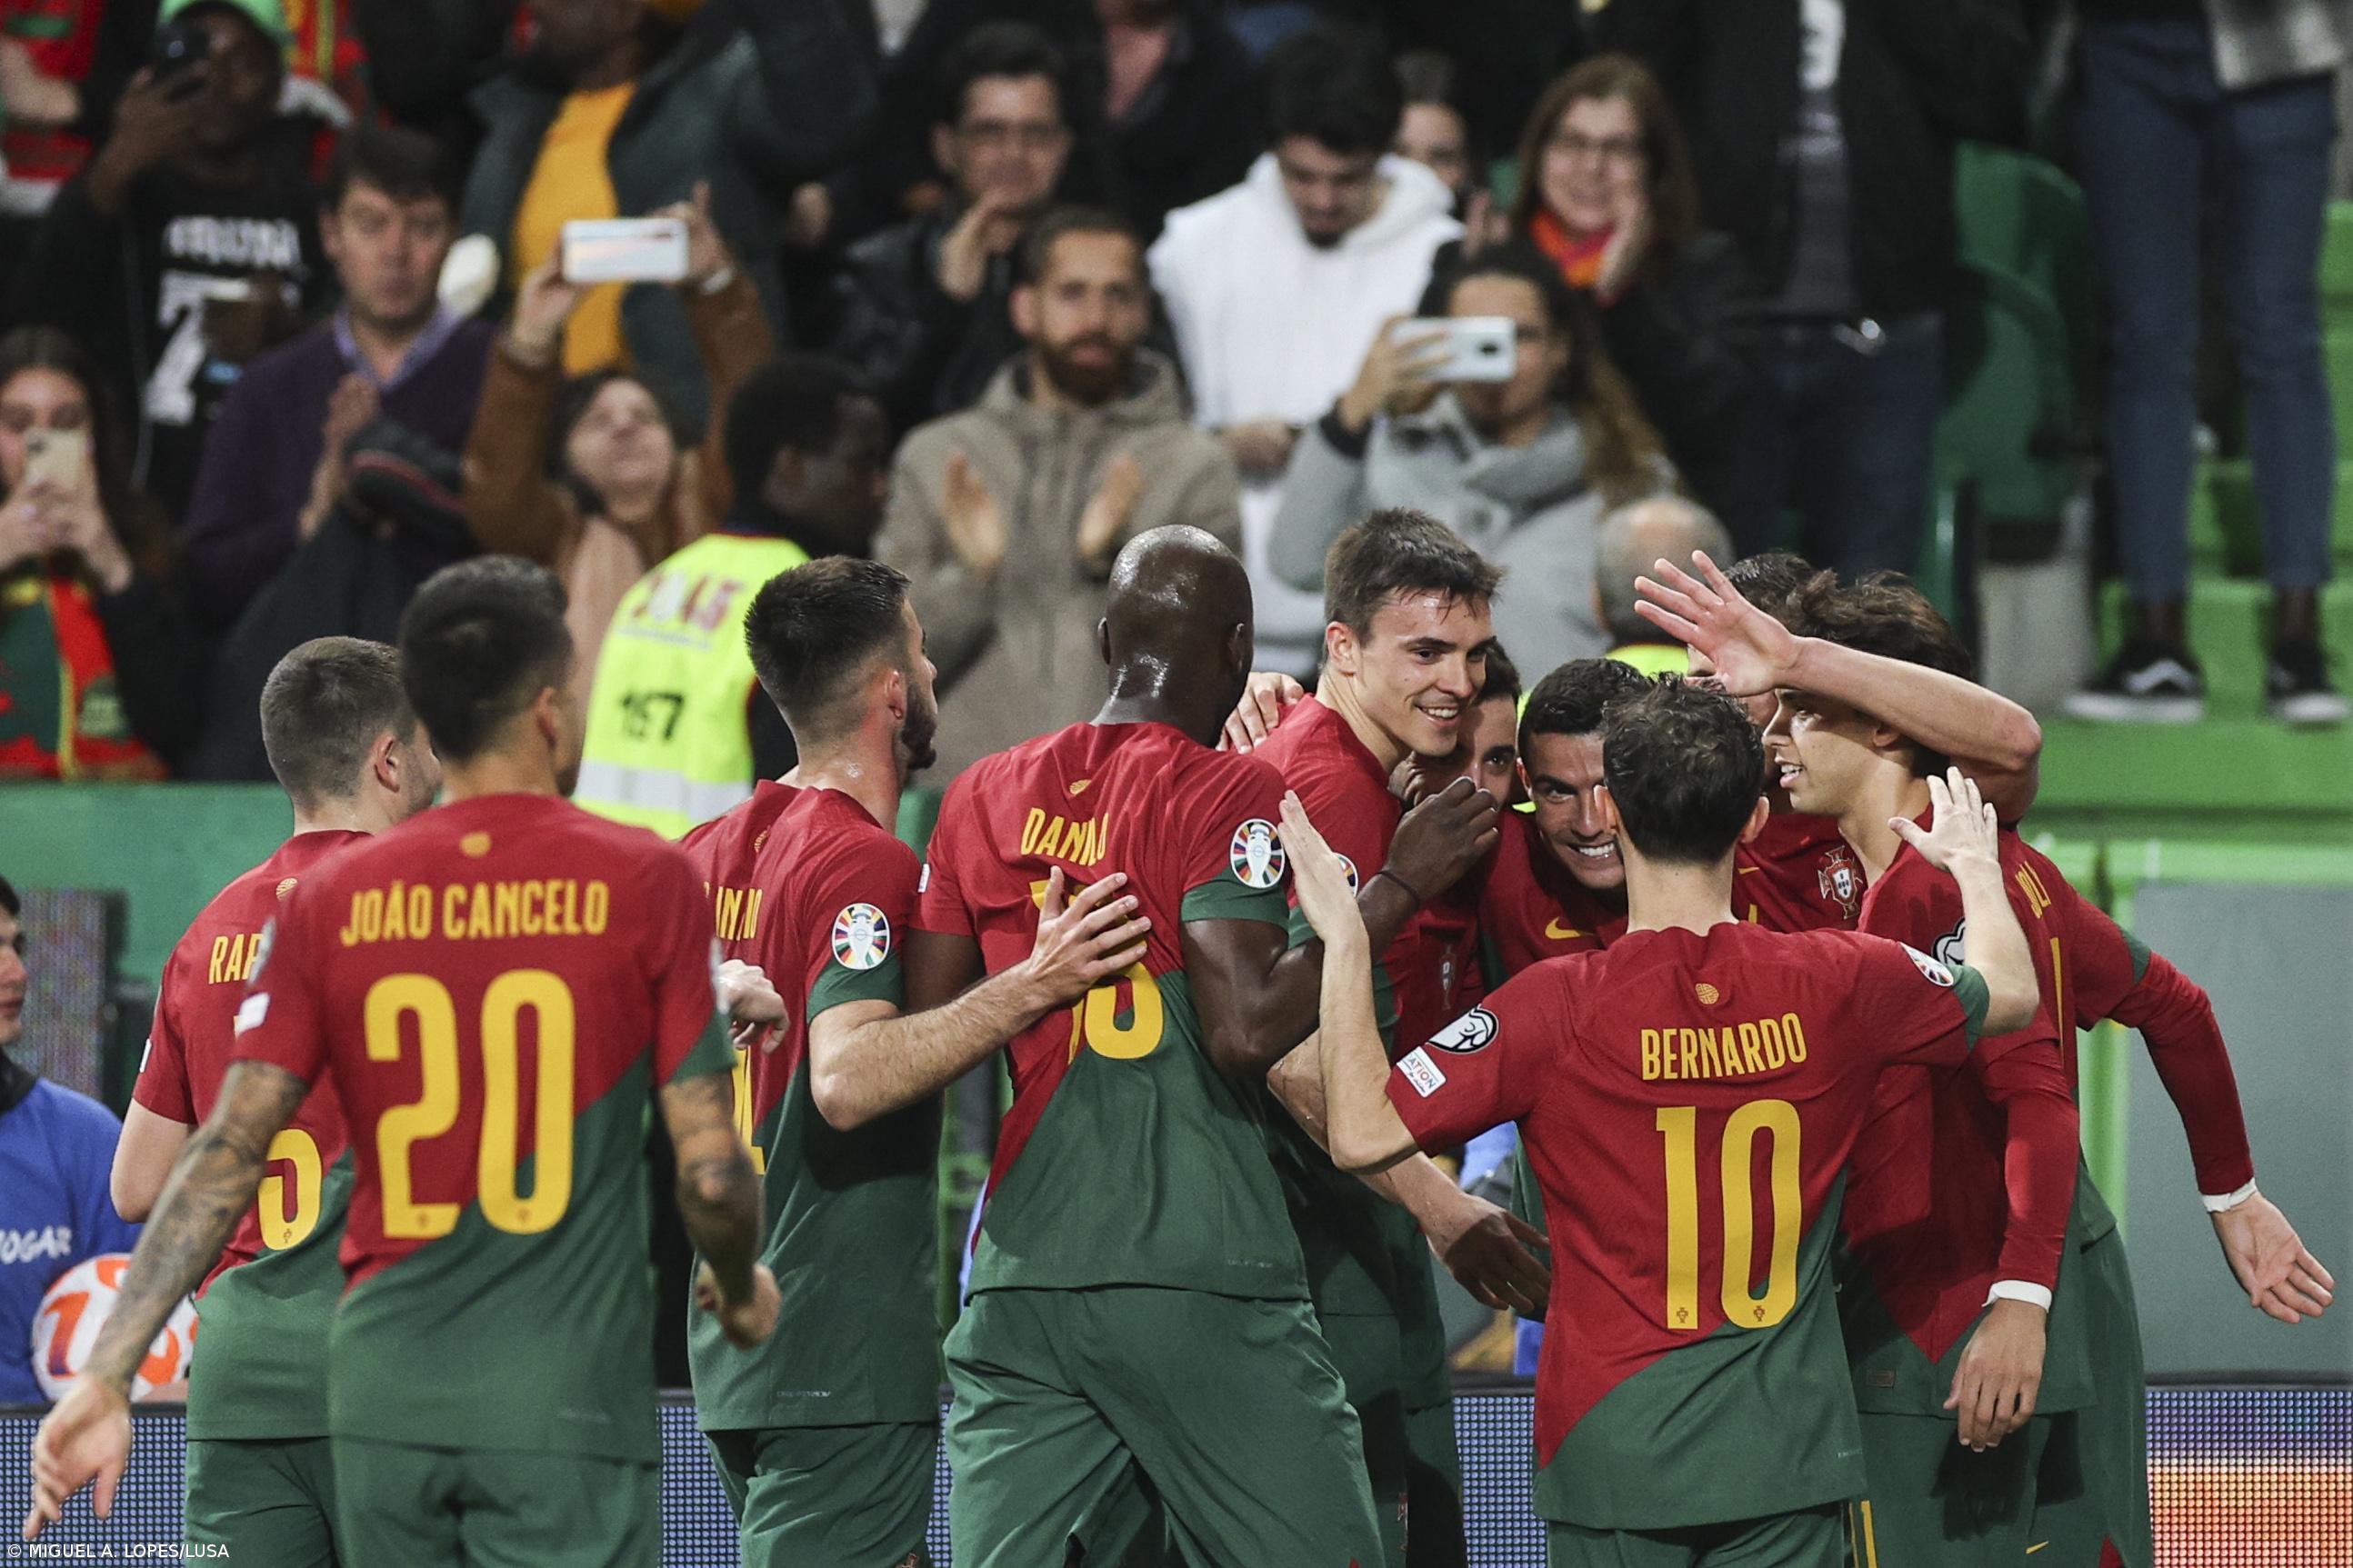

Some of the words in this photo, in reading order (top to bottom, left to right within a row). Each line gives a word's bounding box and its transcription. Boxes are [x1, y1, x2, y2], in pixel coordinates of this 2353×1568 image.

[442, 879, 610, 941] CANCELO
[365, 967, 576, 1239] 20
[1641, 1013, 1807, 1081] BERNARDO
[1656, 1098, 1802, 1331] 10
